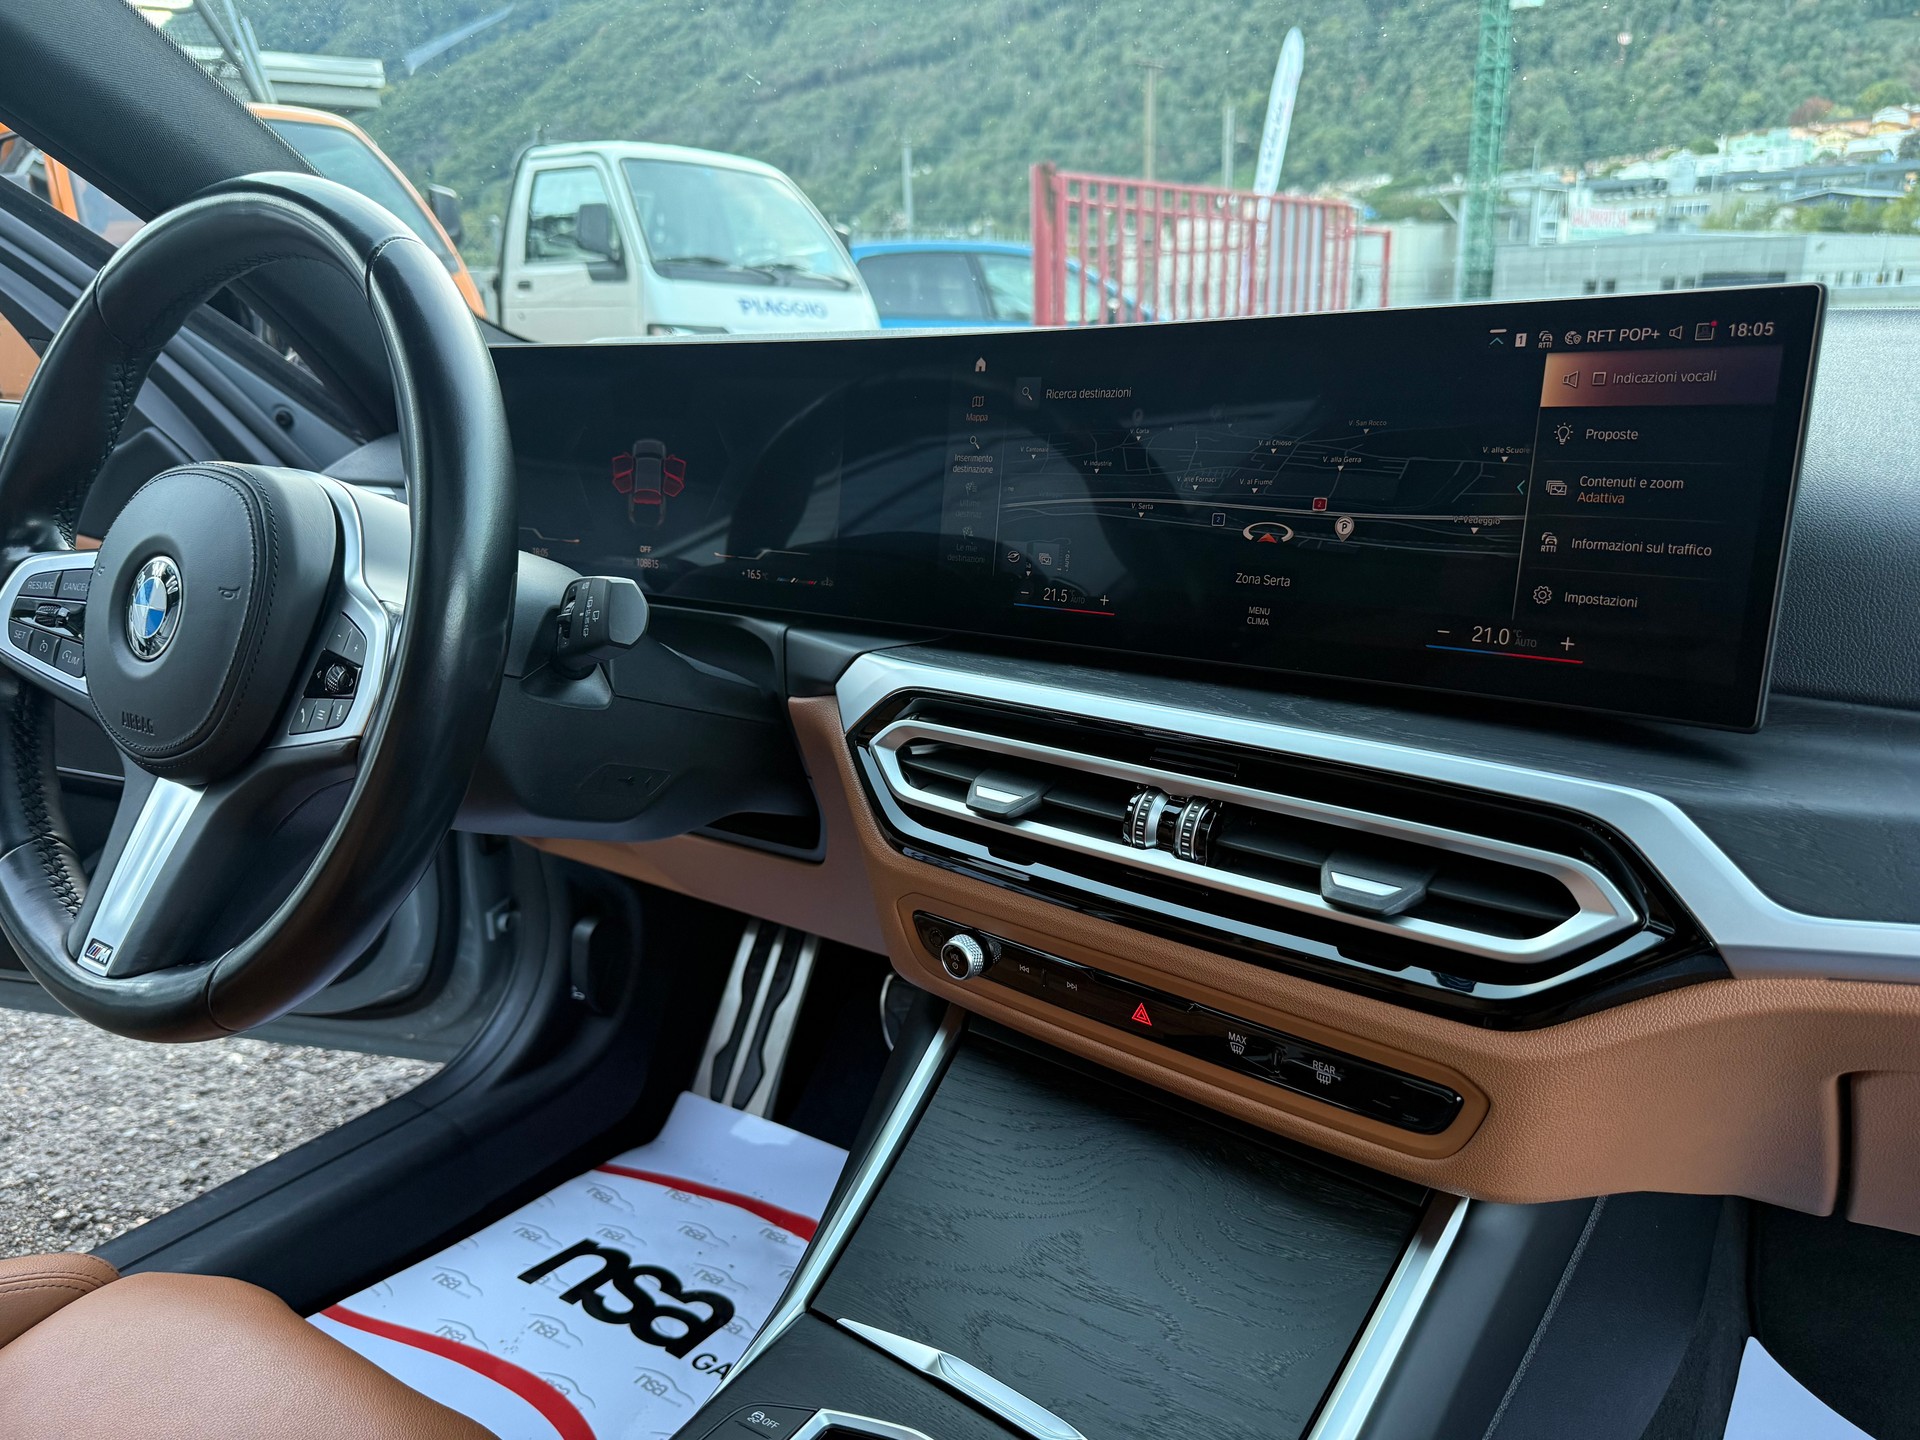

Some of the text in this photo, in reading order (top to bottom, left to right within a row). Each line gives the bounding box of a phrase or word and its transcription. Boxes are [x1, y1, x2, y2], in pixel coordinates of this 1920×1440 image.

[737, 297, 829, 320] PIAGGIO
[1586, 328, 1661, 344] RFT POP+
[1728, 322, 1775, 338] 18:05
[1612, 370, 1717, 384] Indicazioni vocali
[1045, 387, 1132, 399] Ricerca destinazioni
[966, 413, 989, 422] Mappa
[1585, 428, 1639, 442] Proposte
[954, 454, 993, 462] Inserimento
[952, 466, 993, 475] destinazione
[1579, 476, 1684, 490] Contenuti e zoom
[1577, 491, 1625, 504] Adattiva
[640, 545, 652, 553] OFF
[1571, 538, 1712, 557] Informazioni sul traffico
[27, 581, 55, 590] RESUME
[1235, 572, 1291, 587] Zona Serta
[1043, 587, 1068, 602] 21.5
[1564, 592, 1638, 608] Impostazioni
[1248, 606, 1271, 616] MENU
[1246, 616, 1270, 626] CLIMA
[14, 631, 26, 640] SET
[1471, 625, 1510, 646] 21.0
[1514, 638, 1538, 648] AUTO
[121, 711, 154, 734] AIRBAG
[950, 953, 960, 962] VOL
[1228, 1031, 1247, 1046] MAX
[1312, 1060, 1336, 1075] REAR
[586, 1187, 613, 1203] nsa
[514, 1227, 542, 1241] nsa
[678, 1225, 708, 1241] nsa
[432, 1272, 462, 1290] nsa
[694, 1269, 724, 1285] nsa
[517, 1238, 735, 1360] nsa
[528, 1319, 560, 1339] nsa
[634, 1373, 668, 1397] nsa
[761, 1417, 781, 1429] OFF
